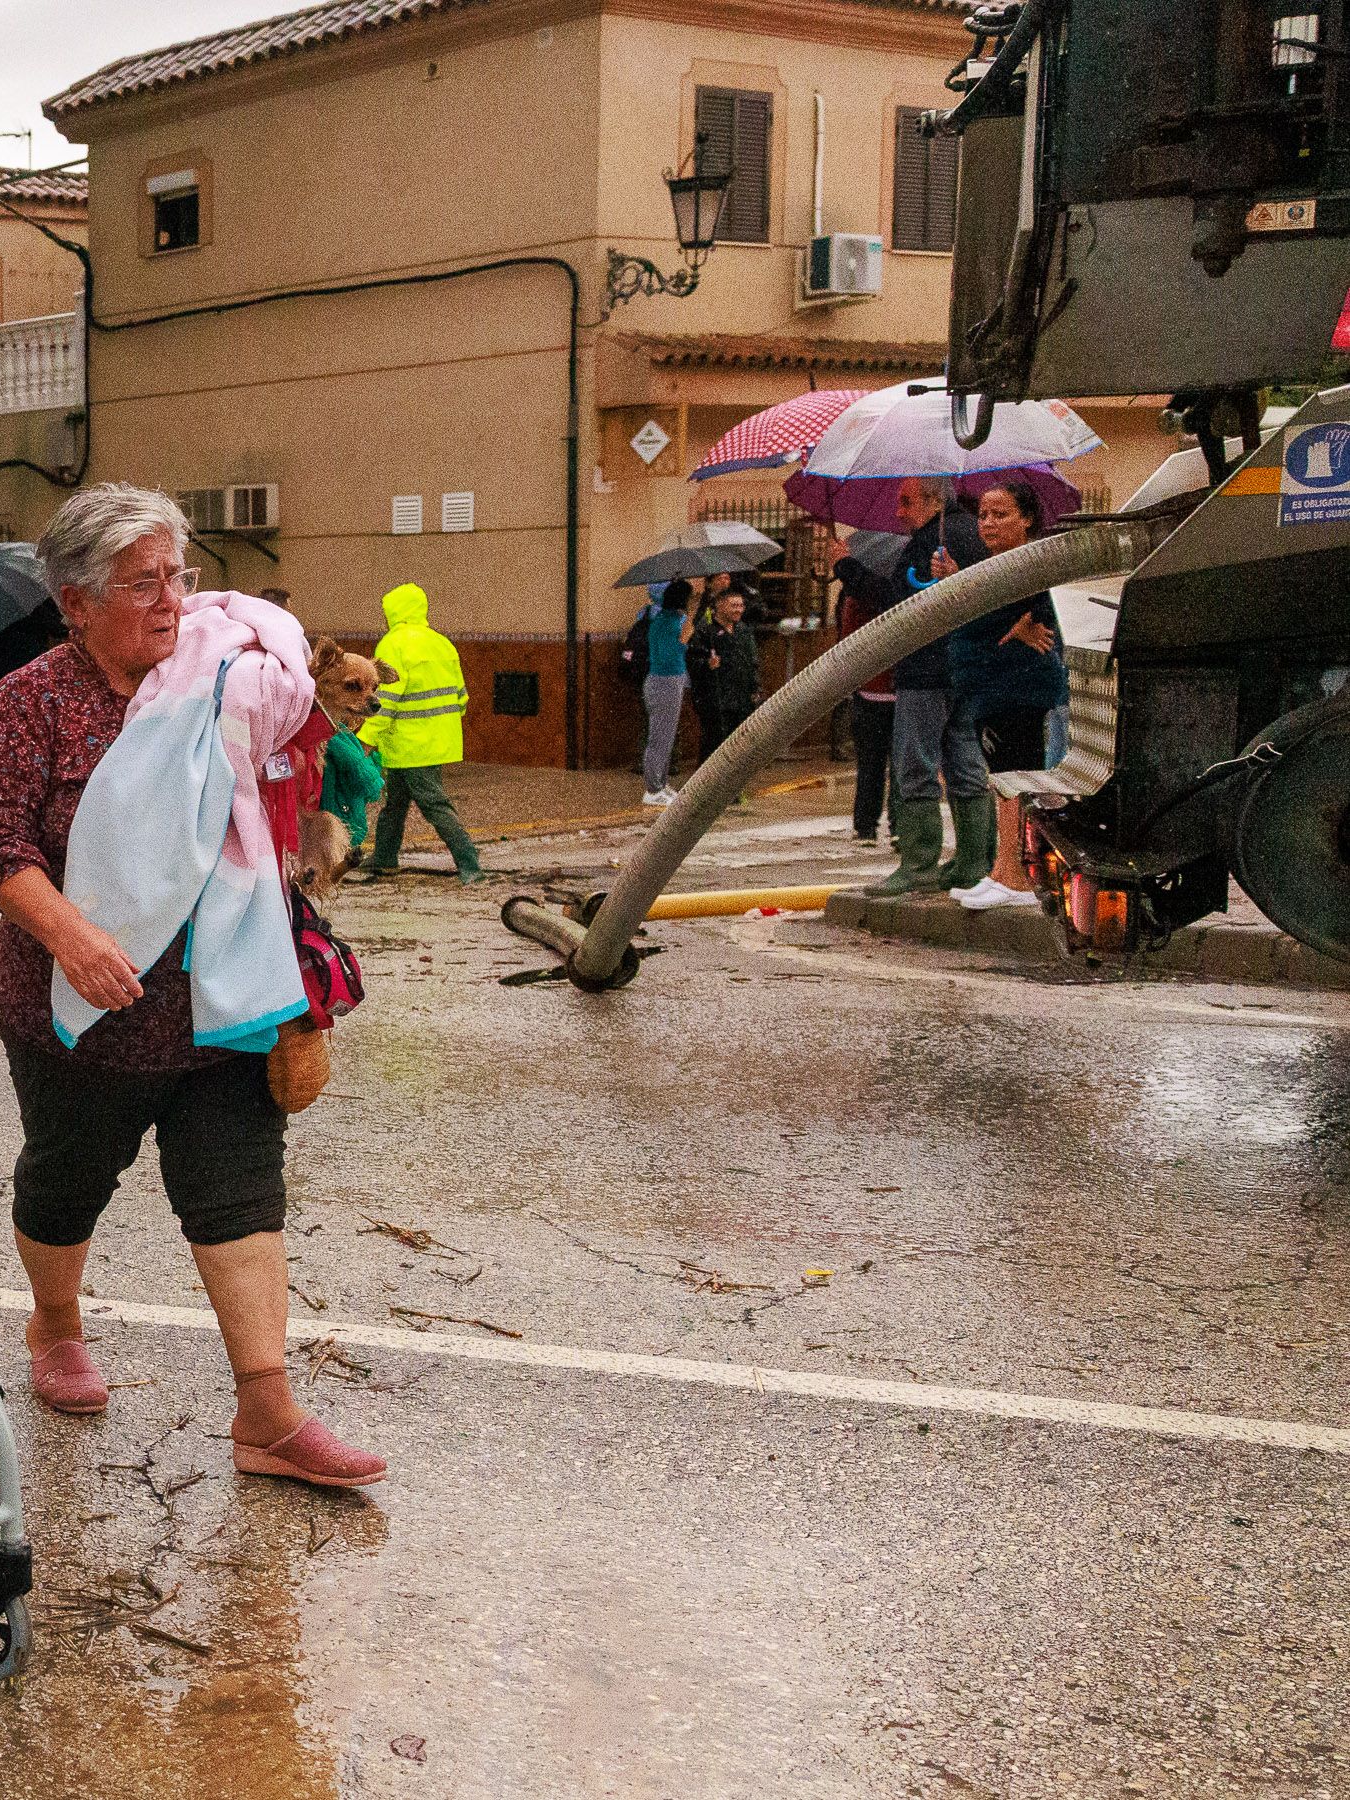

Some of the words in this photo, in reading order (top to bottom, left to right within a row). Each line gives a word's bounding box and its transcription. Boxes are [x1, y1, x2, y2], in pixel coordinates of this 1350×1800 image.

[1292, 501, 1302, 509] ES
[1284, 513, 1294, 521] EL
[1296, 511, 1312, 520] USO
[1313, 511, 1324, 519] DE
